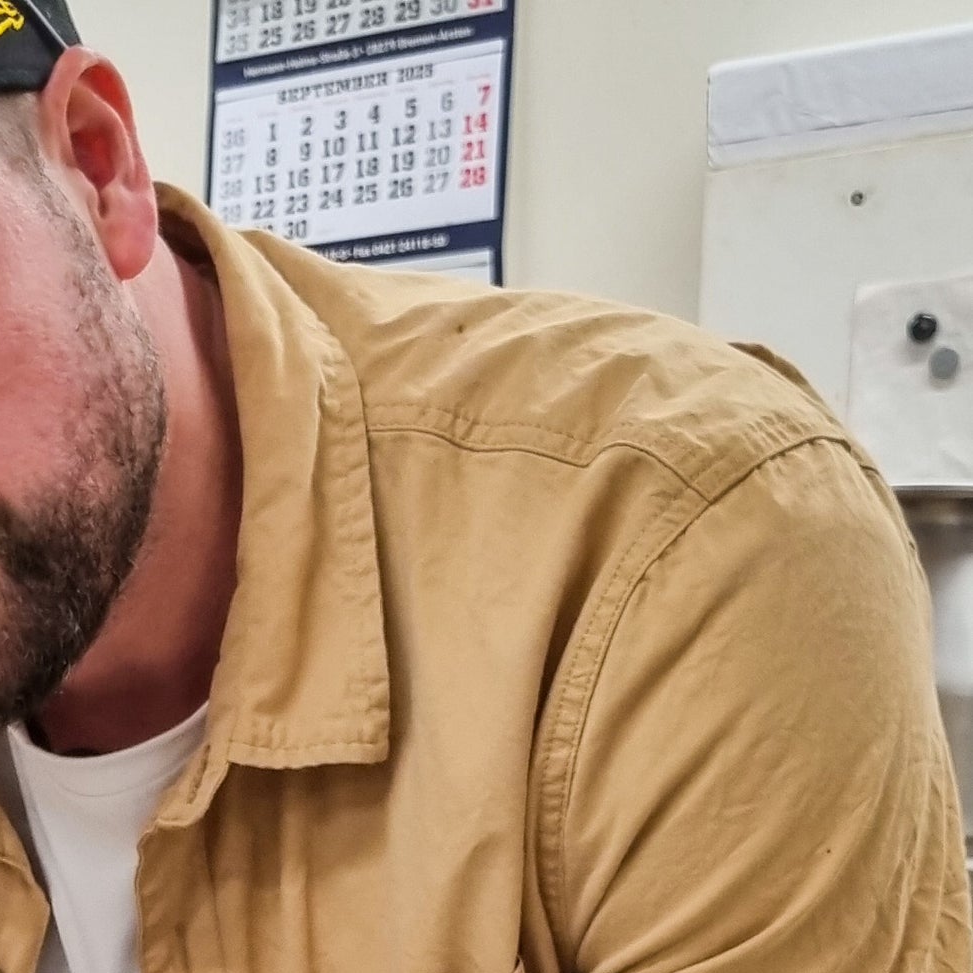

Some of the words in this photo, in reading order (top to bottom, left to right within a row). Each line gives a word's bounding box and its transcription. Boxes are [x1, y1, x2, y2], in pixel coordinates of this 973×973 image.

[258, 26, 282, 48] 25
[291, 20, 315, 42] 26
[325, 13, 350, 35] 27
[359, 6, 384, 29] 28
[394, 0, 420, 23] 29
[277, 71, 388, 105] SEPTEMBER
[396, 63, 434, 82] 2025
[266, 148, 277, 167] 8
[299, 142, 312, 161] 9
[323, 136, 345, 158] 10
[357, 130, 378, 152] 11
[391, 124, 415, 147] 12
[427, 118, 452, 141] 13
[463, 112, 487, 135] 14
[269, 123, 276, 142] 1
[300, 116, 313, 136] 2
[334, 110, 347, 130] 3
[369, 104, 380, 124] 4
[405, 98, 417, 118] 5
[440, 91, 454, 112] 6
[478, 84, 491, 106] 7
[252, 199, 274, 220] 22
[286, 193, 308, 215] 23
[318, 188, 343, 211] 24
[354, 183, 378, 205] 25
[388, 177, 413, 199] 26
[423, 171, 450, 194] 27
[460, 166, 486, 189] 28
[254, 173, 276, 194] 15
[288, 167, 309, 189] 16
[322, 162, 345, 184] 17
[356, 157, 379, 179] 18
[391, 150, 415, 173] 19
[424, 145, 451, 168] 20
[462, 140, 486, 162] 21
[285, 219, 308, 240] 30
